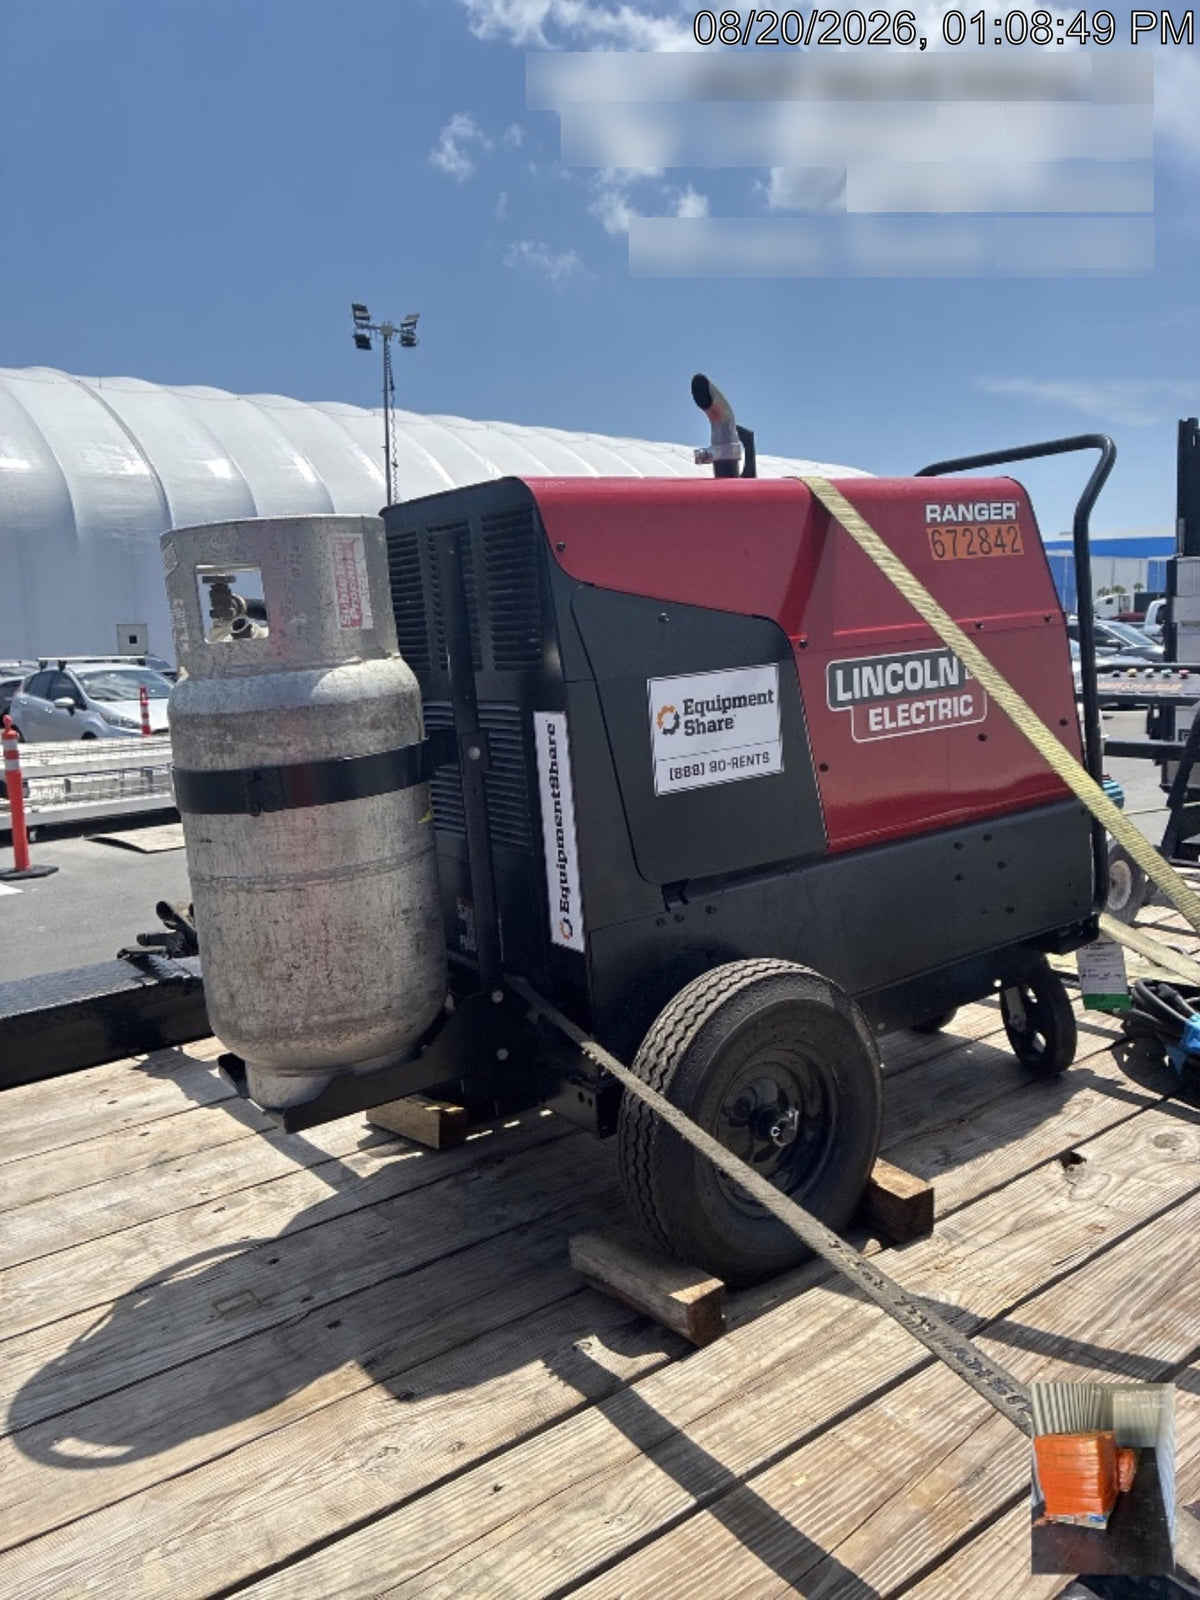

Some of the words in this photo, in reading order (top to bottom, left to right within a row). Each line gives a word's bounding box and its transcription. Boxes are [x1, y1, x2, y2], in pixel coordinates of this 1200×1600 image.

[925, 502, 1016, 523] RANGER
[931, 526, 1021, 559] 672842
[835, 656, 959, 702] LINCOLN
[682, 689, 774, 717] Equipment
[868, 694, 974, 732] ELECTRIC
[684, 716, 735, 737] Share
[708, 751, 771, 773] 90-RENTS
[546, 722, 570, 914] EquipmentShare
